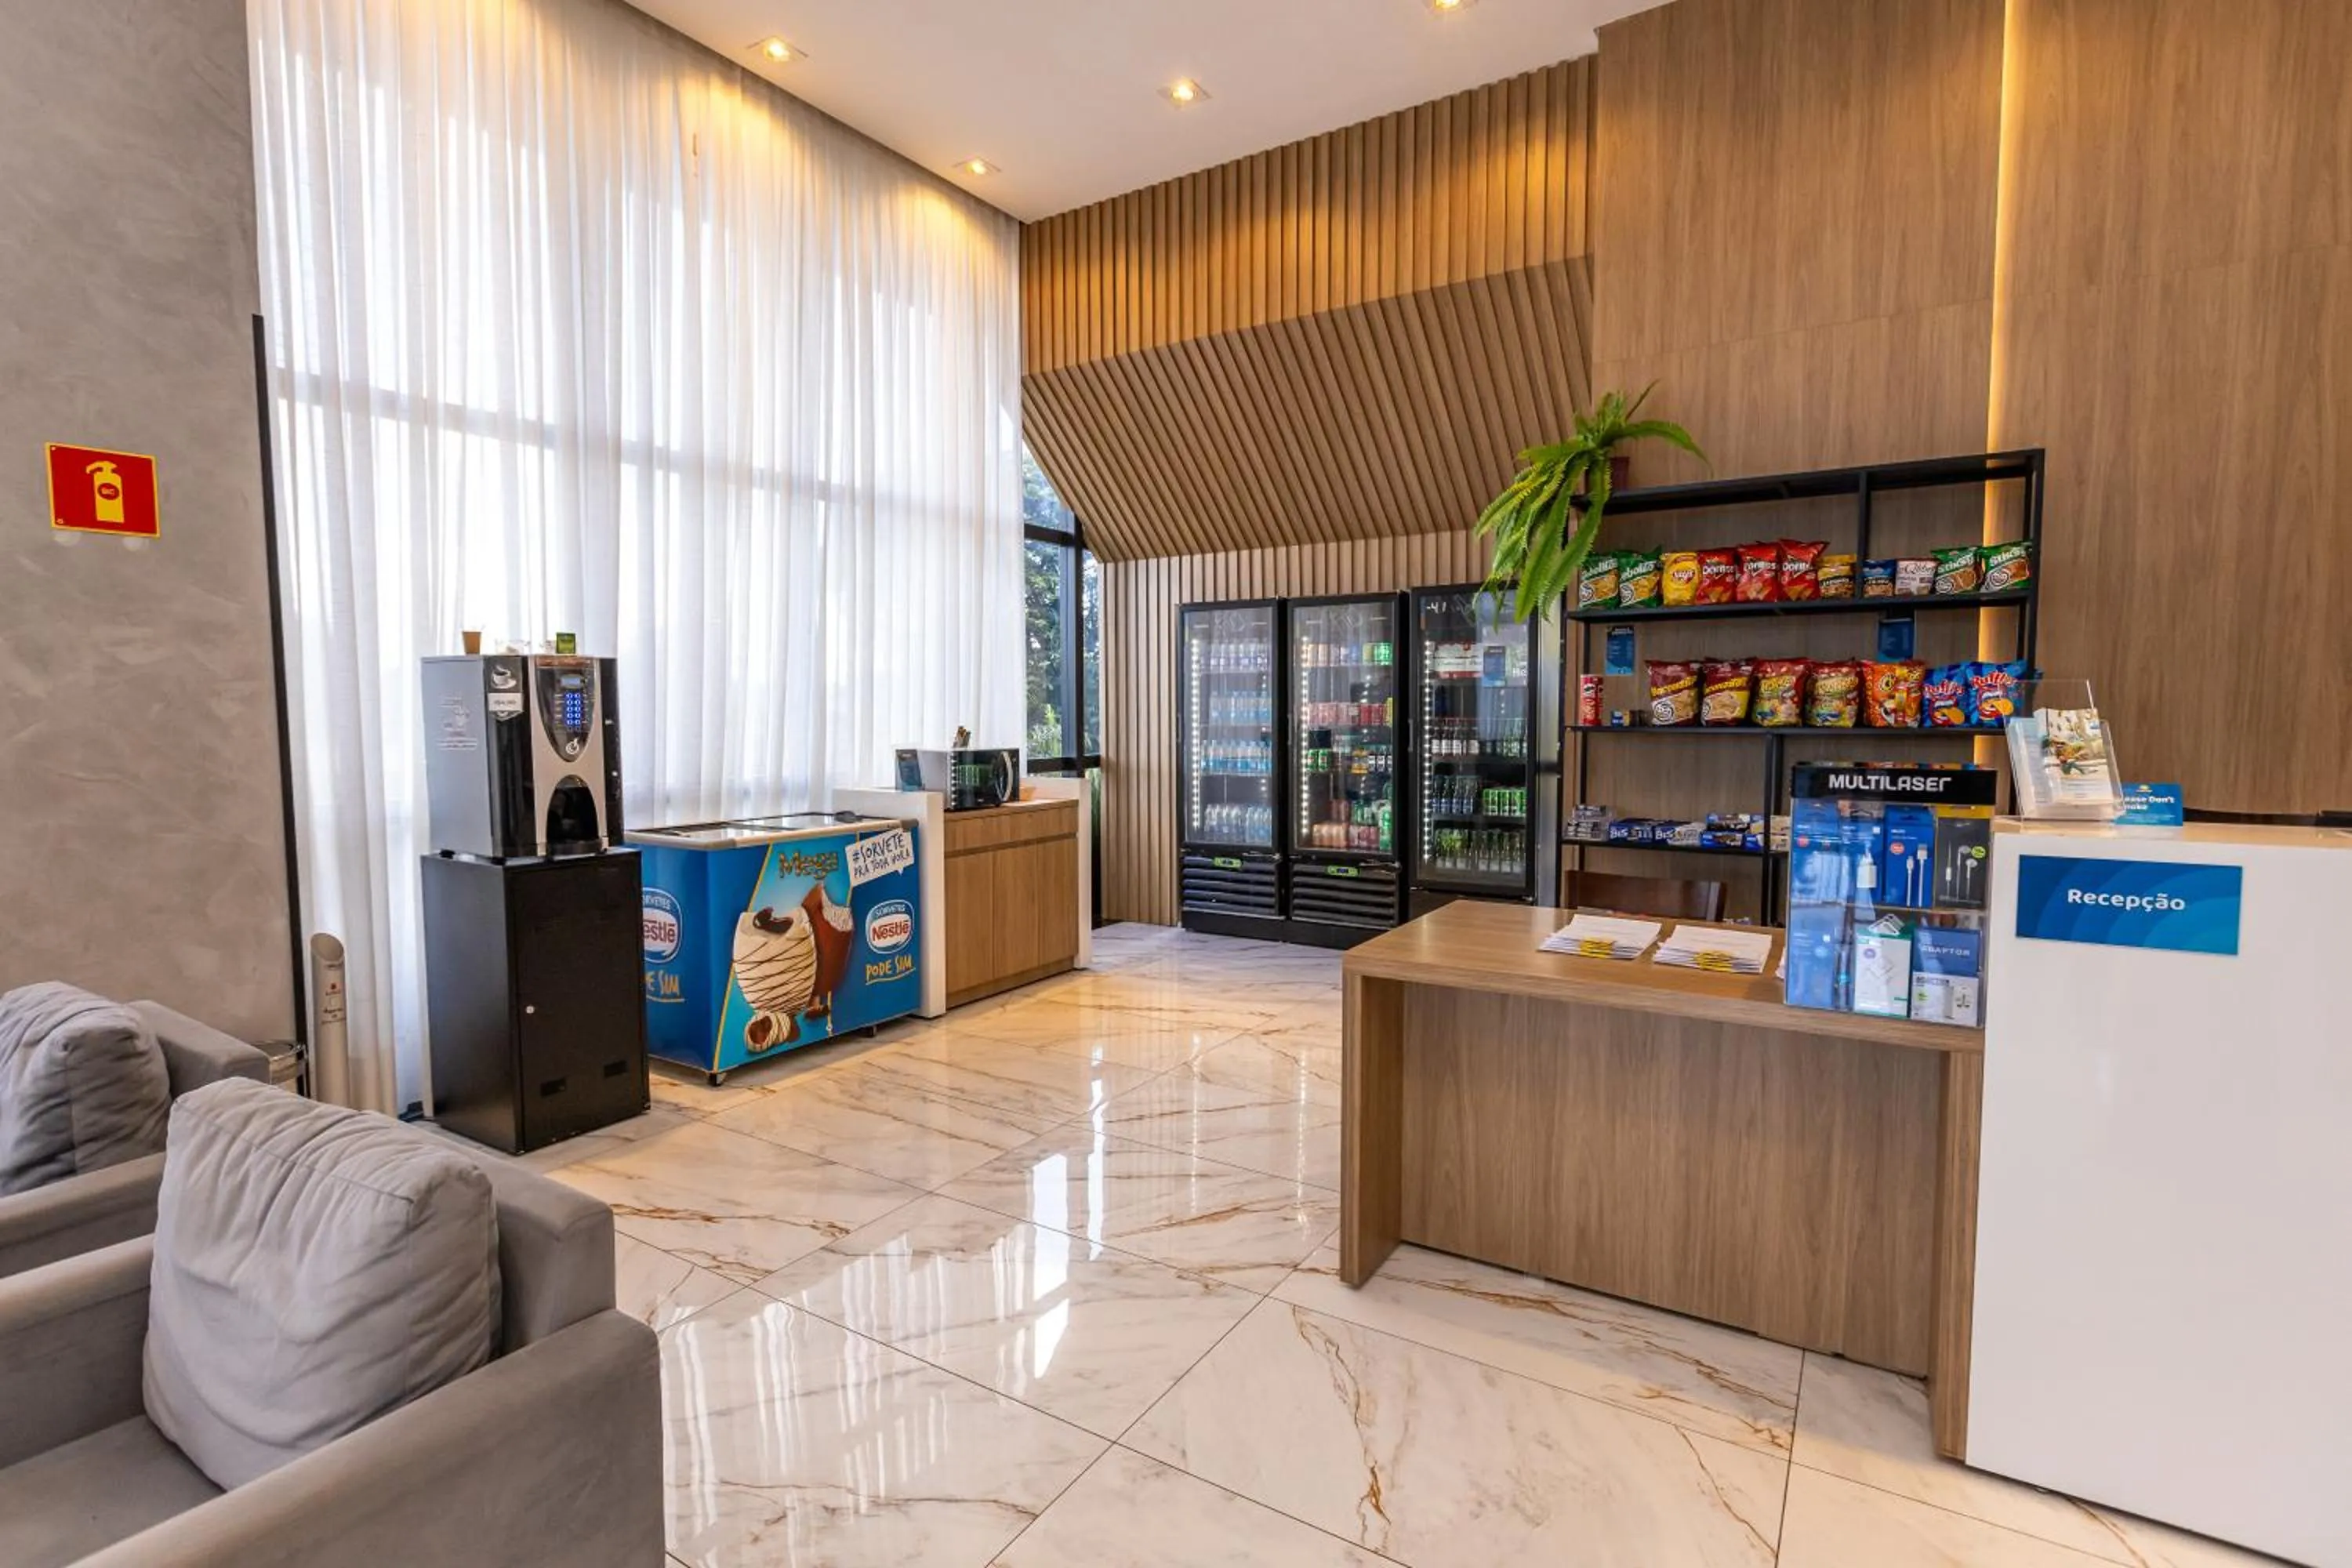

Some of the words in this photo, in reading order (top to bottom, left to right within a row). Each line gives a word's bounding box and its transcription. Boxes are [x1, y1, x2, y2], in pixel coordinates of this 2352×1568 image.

[2067, 888, 2186, 912] Recepção
[643, 919, 676, 943] estlé
[871, 920, 909, 942] Nestlé
[866, 959, 892, 983] PODE
[895, 954, 913, 974] SIM
